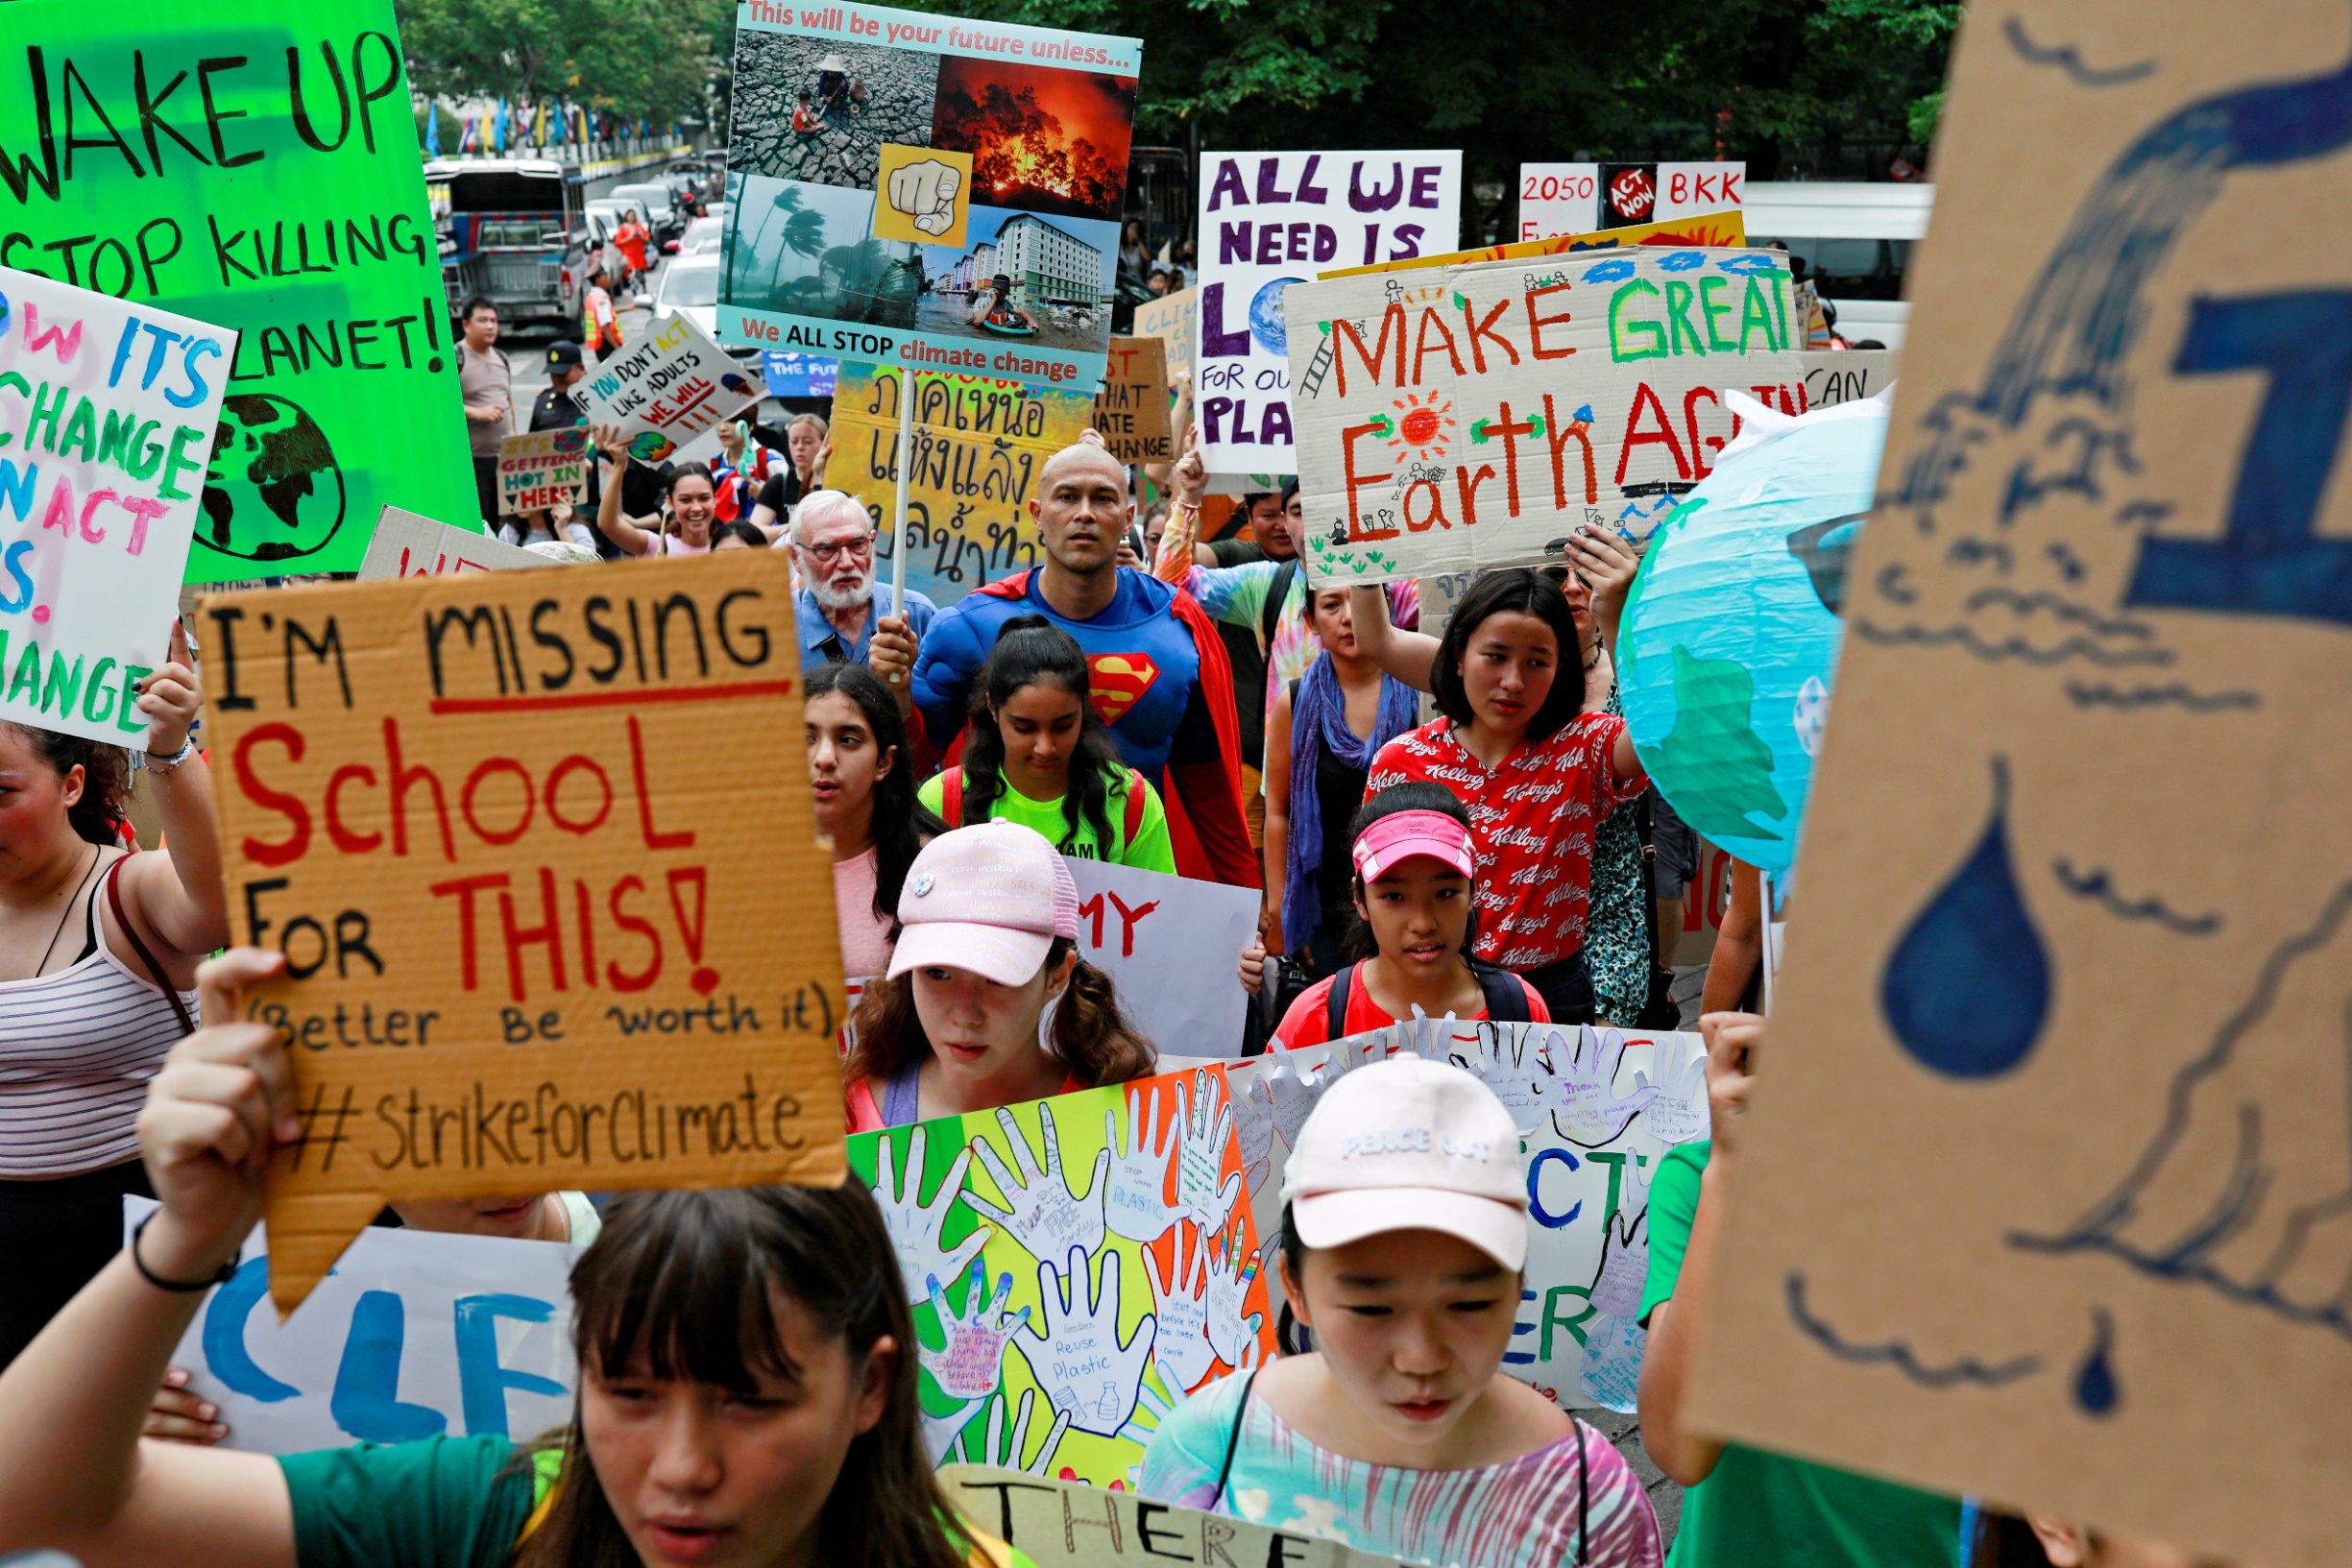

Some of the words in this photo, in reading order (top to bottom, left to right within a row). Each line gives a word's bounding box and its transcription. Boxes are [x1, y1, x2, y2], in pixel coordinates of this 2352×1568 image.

[750, 0, 793, 26] This
[800, 9, 842, 32] will
[850, 12, 879, 36] be
[886, 23, 940, 47] your
[948, 26, 1024, 55] future
[0, 45, 264, 205] WAKE
[286, 32, 400, 155] UP
[1206, 155, 1329, 213] ALL
[1346, 161, 1442, 213] WE
[1522, 177, 1593, 201] 2050
[1670, 171, 1741, 205] BKK
[1611, 168, 1643, 205] ACT
[1619, 186, 1655, 217] NOW
[0, 217, 182, 298] STOP
[207, 213, 425, 286] KILLING
[1220, 221, 1337, 265] NEED
[1362, 223, 1424, 265] IS
[109, 316, 222, 408] IT'S
[741, 317, 780, 342] We
[787, 325, 828, 349] ALL
[834, 330, 893, 356] STOP
[900, 339, 987, 370] climate
[993, 350, 1078, 382] change
[1331, 283, 1577, 398] MAKE
[1609, 268, 1793, 363] GREAT
[573, 391, 592, 413] IF
[589, 372, 621, 400] YOU
[615, 343, 660, 382] DON'T
[654, 320, 691, 355] ACT
[612, 387, 646, 418] LIKE
[648, 350, 701, 394] ADULTS
[769, 362, 804, 375] THE
[1201, 363, 1245, 391] FOR
[640, 399, 674, 426] WE
[670, 375, 712, 406] WILL
[501, 450, 585, 472] GETTING
[505, 437, 548, 454] IT'S
[1343, 393, 1597, 543] Earth
[504, 471, 545, 491] HOT
[553, 465, 580, 483] IN
[43, 473, 171, 557] ACT
[206, 608, 354, 712] I'M
[424, 588, 773, 698] MISSING
[429, 865, 723, 1004] THIS!
[500, 1007, 565, 1046] Be
[607, 993, 762, 1039] worth
[780, 980, 836, 1039] it)
[1343, 1126, 1430, 1160] PEACE
[1442, 1136, 1490, 1164] OUT
